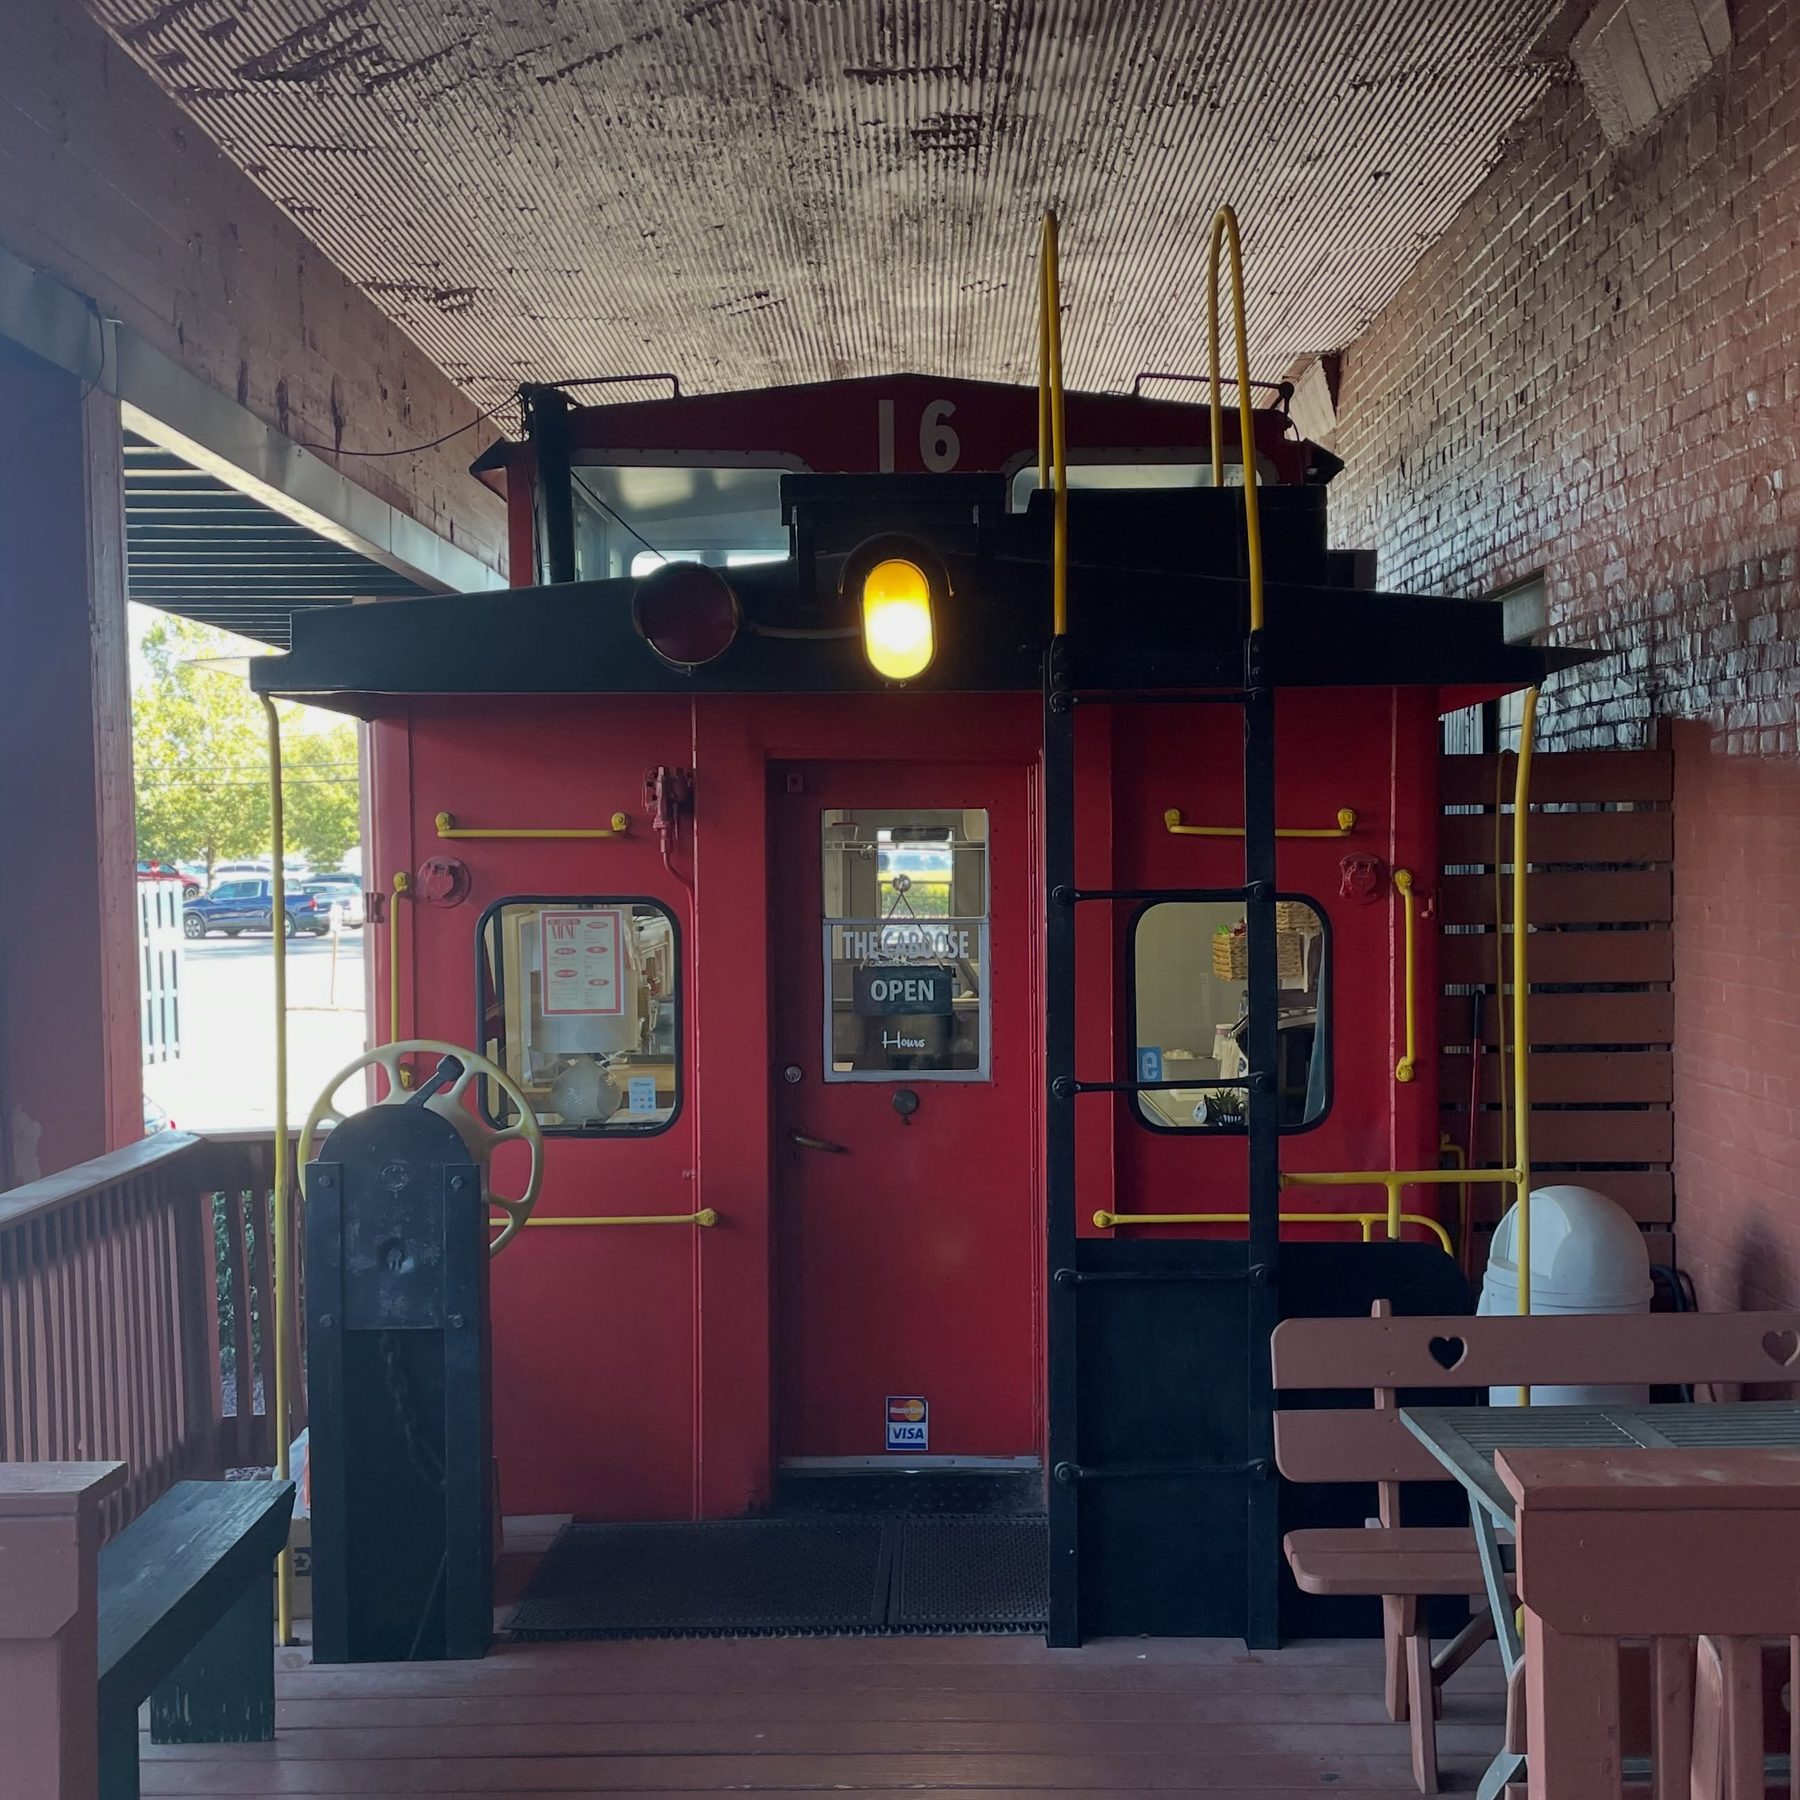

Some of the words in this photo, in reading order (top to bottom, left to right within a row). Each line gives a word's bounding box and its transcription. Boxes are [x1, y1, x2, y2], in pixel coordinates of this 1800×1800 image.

[878, 399, 961, 473] 16
[842, 931, 881, 959] THE
[882, 931, 969, 959] CABOOSE
[870, 979, 935, 1003] OPEN
[881, 1030, 926, 1050] Hours
[892, 1427, 925, 1440] VISA
